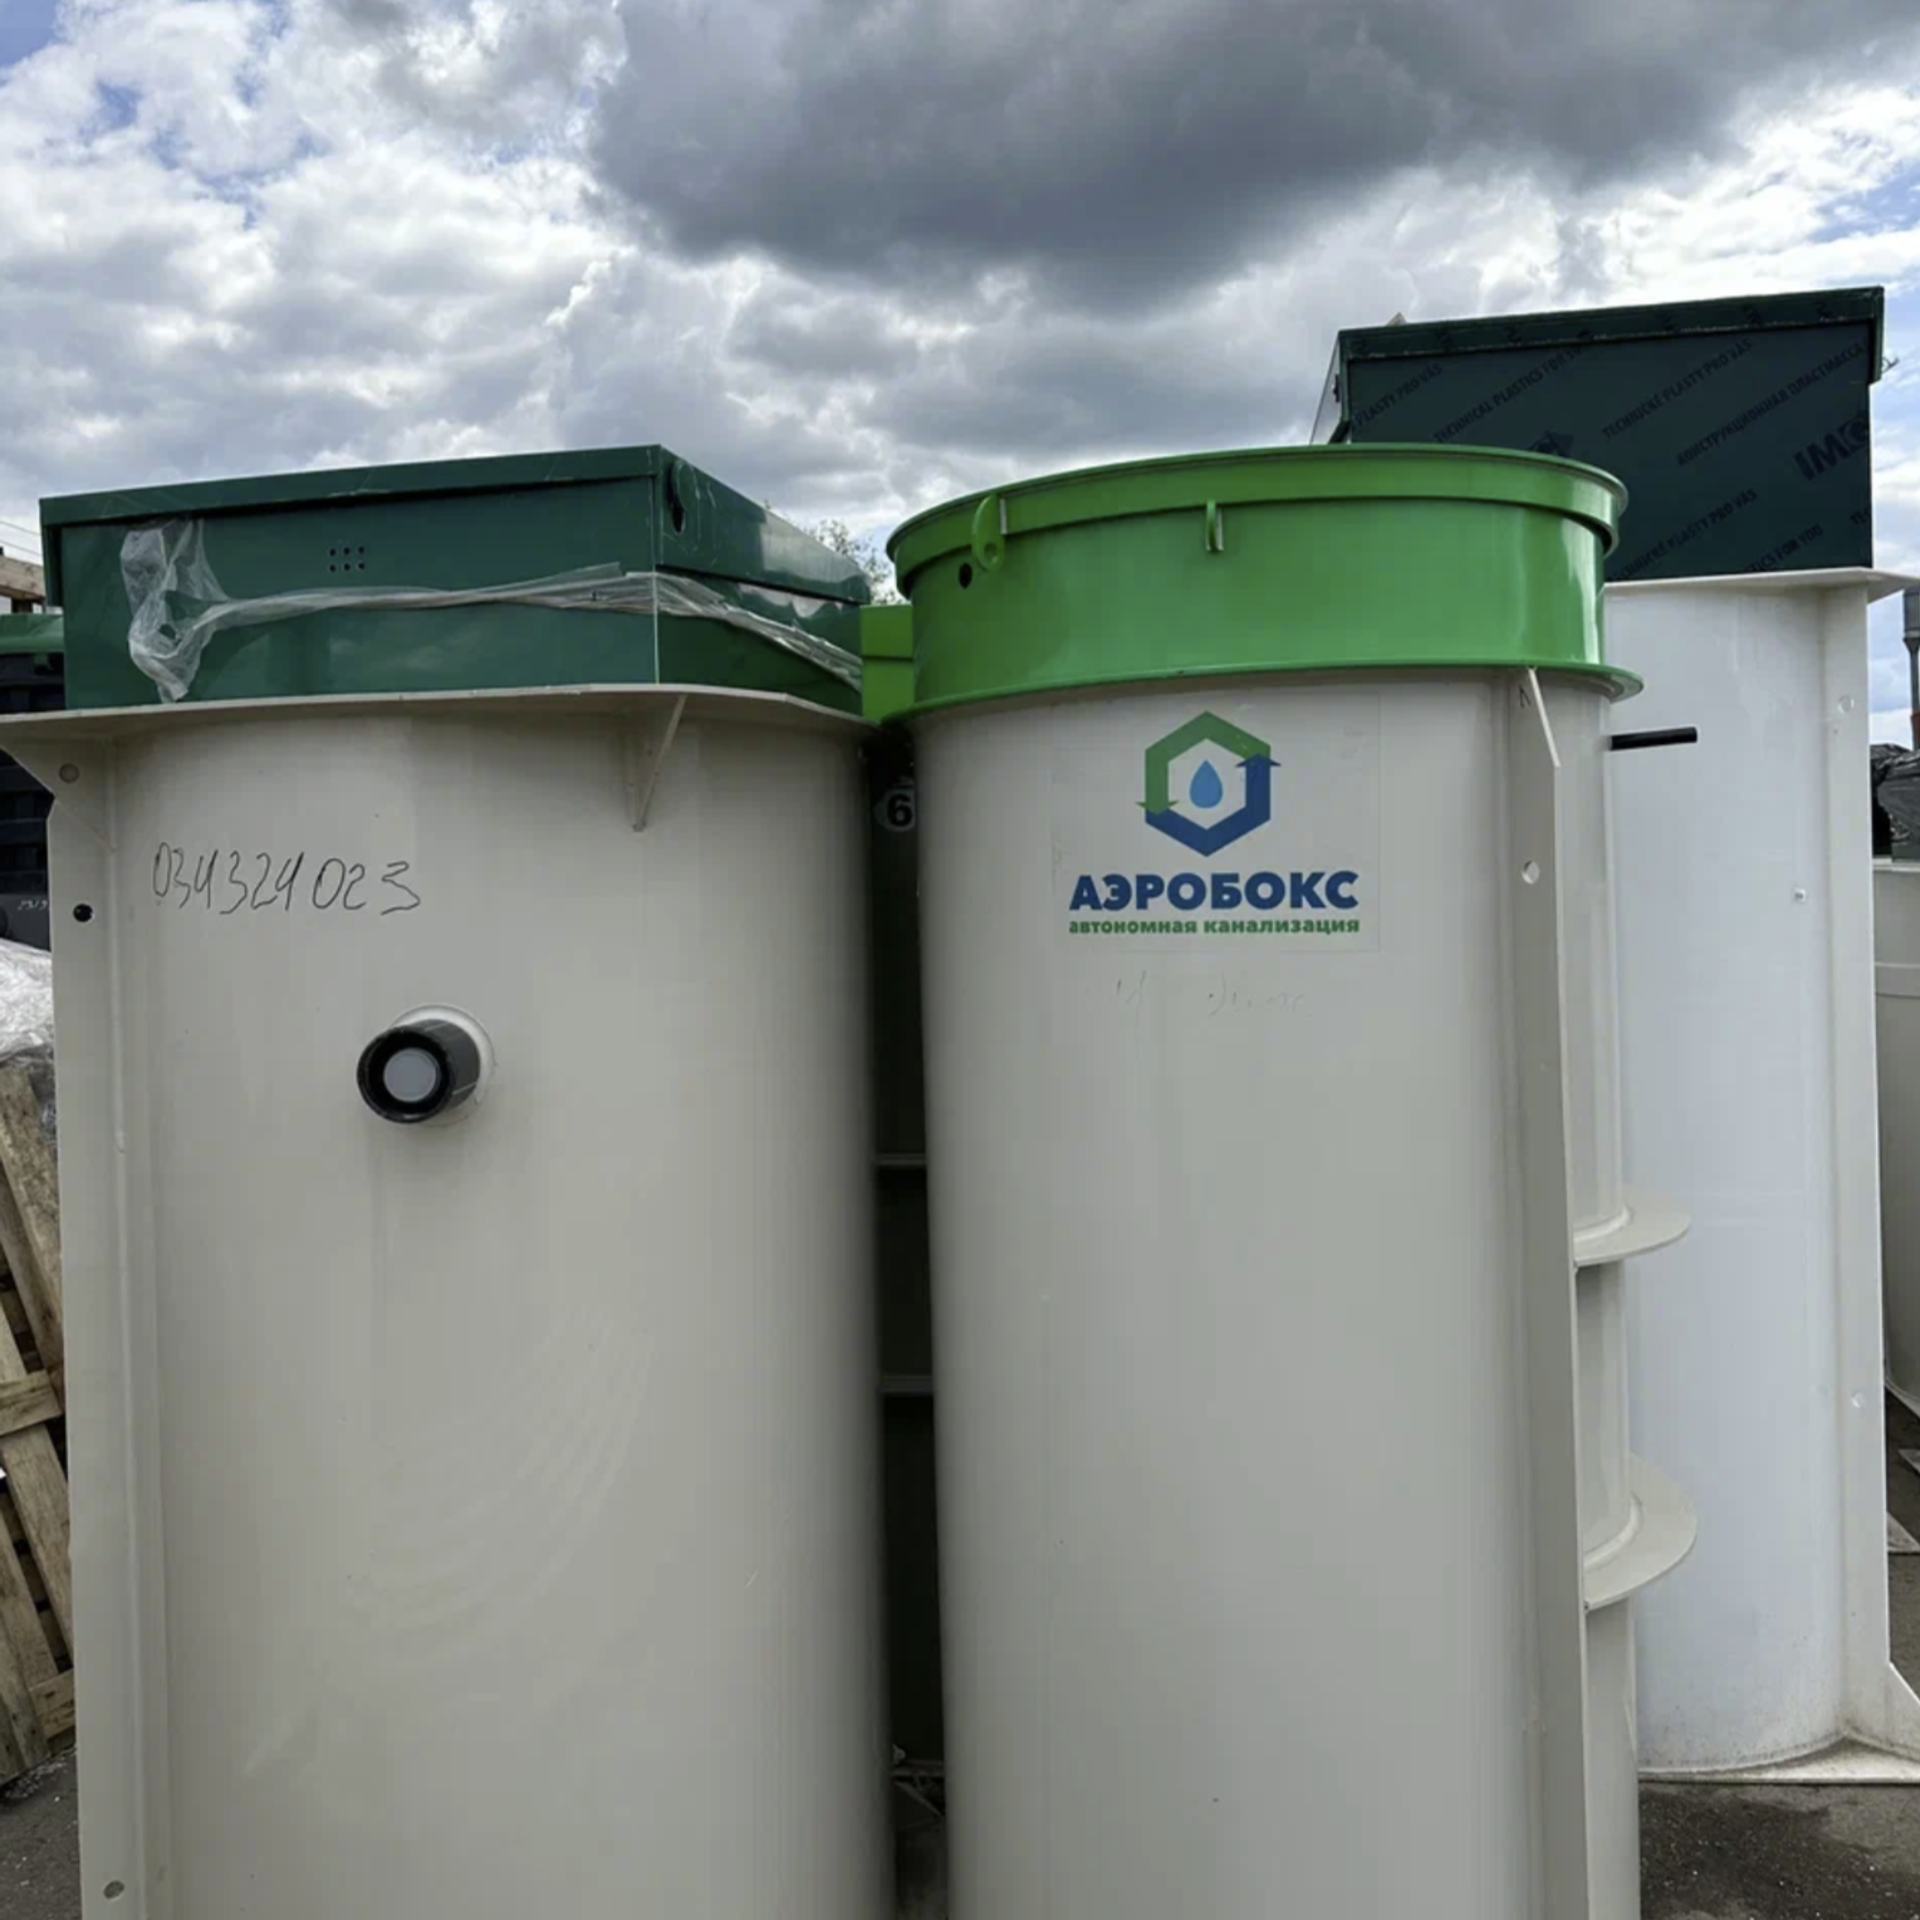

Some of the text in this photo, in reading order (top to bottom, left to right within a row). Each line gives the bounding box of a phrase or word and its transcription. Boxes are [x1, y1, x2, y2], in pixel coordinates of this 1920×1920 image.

[1662, 370, 1704, 402] PLASTY
[1703, 354, 1729, 375] PRO
[1355, 394, 1396, 426] PLASTY
[1395, 378, 1420, 399] PRO
[1434, 402, 1493, 442] TECHNICAL
[1492, 370, 1543, 405] PLASTICS
[1667, 518, 1709, 549] PLASTY
[1708, 502, 1733, 525] PRO
[1775, 538, 1800, 560] FOR
[1799, 523, 1824, 545] YOU
[1069, 871, 1359, 911] АЭРОБОКС
[1069, 918, 1360, 935] автономная канализация
